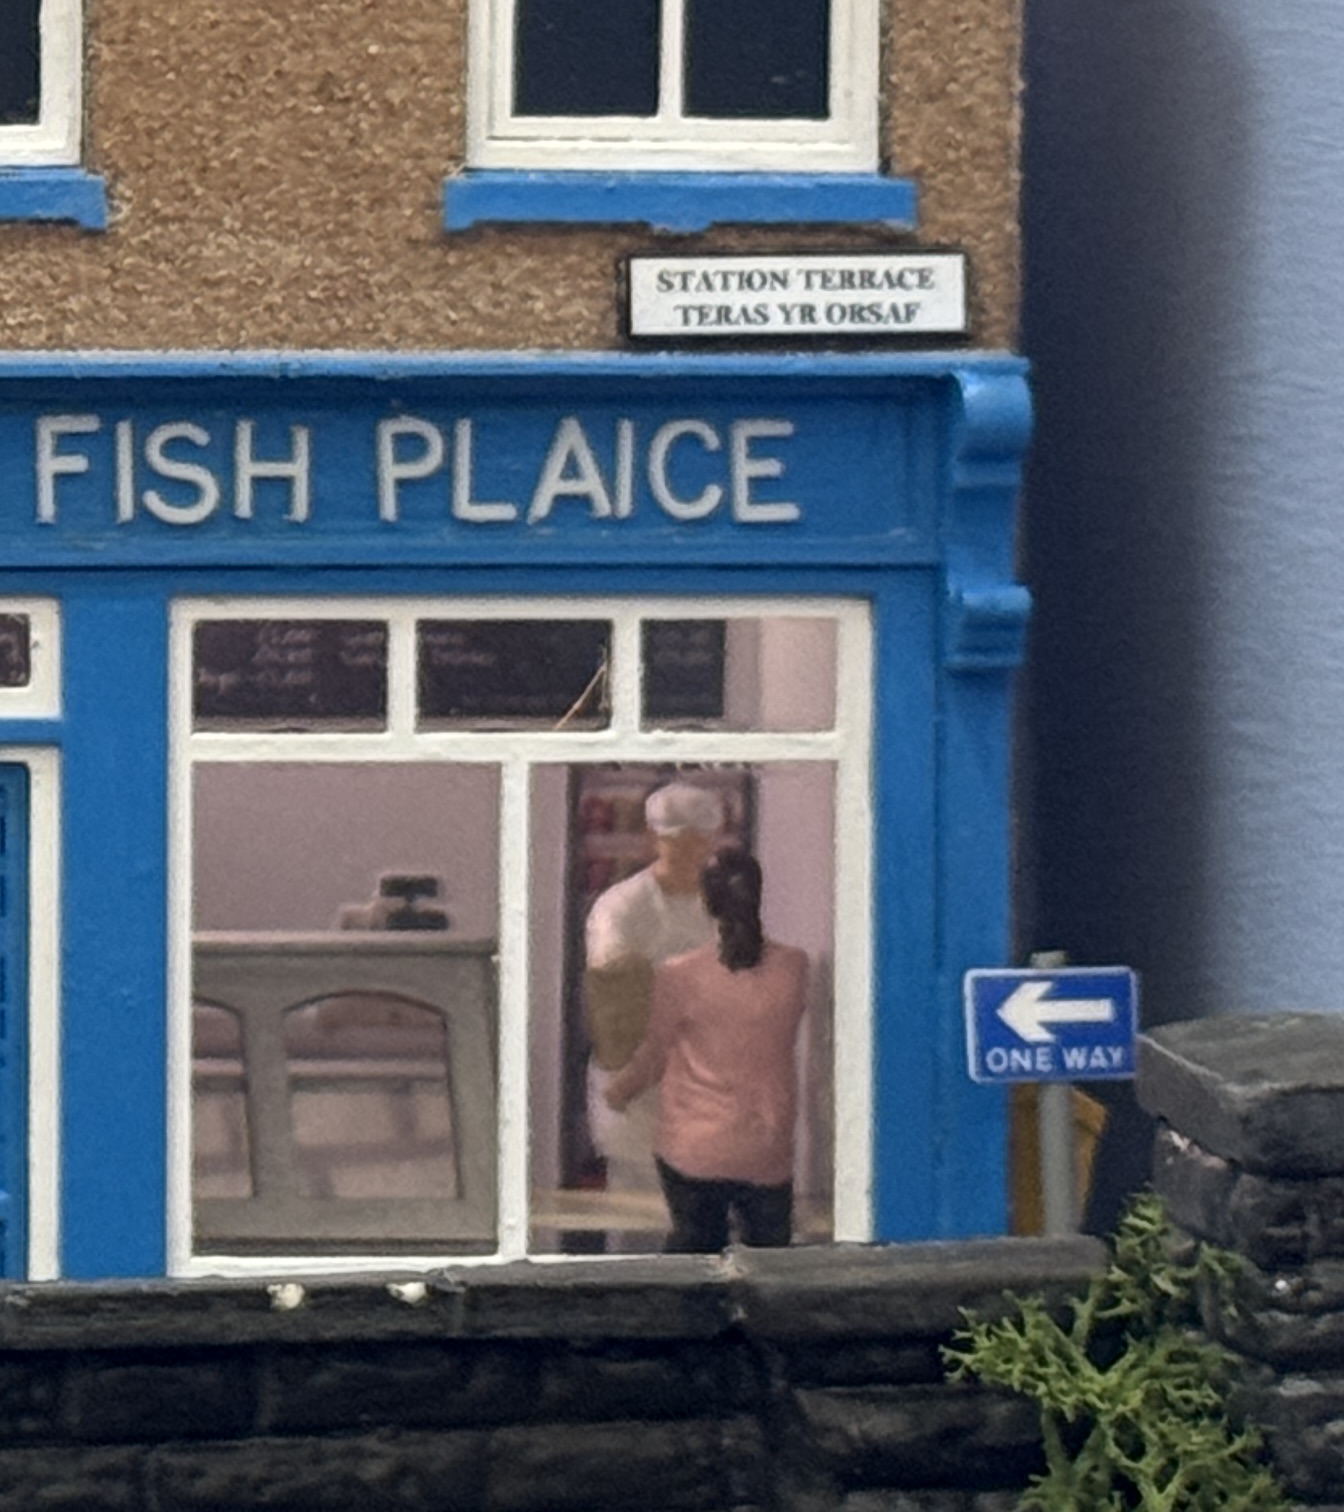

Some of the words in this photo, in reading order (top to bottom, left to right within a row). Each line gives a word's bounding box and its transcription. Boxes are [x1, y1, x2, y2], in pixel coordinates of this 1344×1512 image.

[657, 268, 789, 293] STATION
[795, 266, 936, 291] TERRACE
[673, 303, 770, 327] TERAS
[777, 302, 819, 326] YR
[825, 301, 921, 326] ORSAF
[35, 414, 310, 525] FISH
[375, 413, 800, 525] PLAICE
[985, 1045, 1054, 1074] ONE
[1062, 1044, 1124, 1071] WAY
